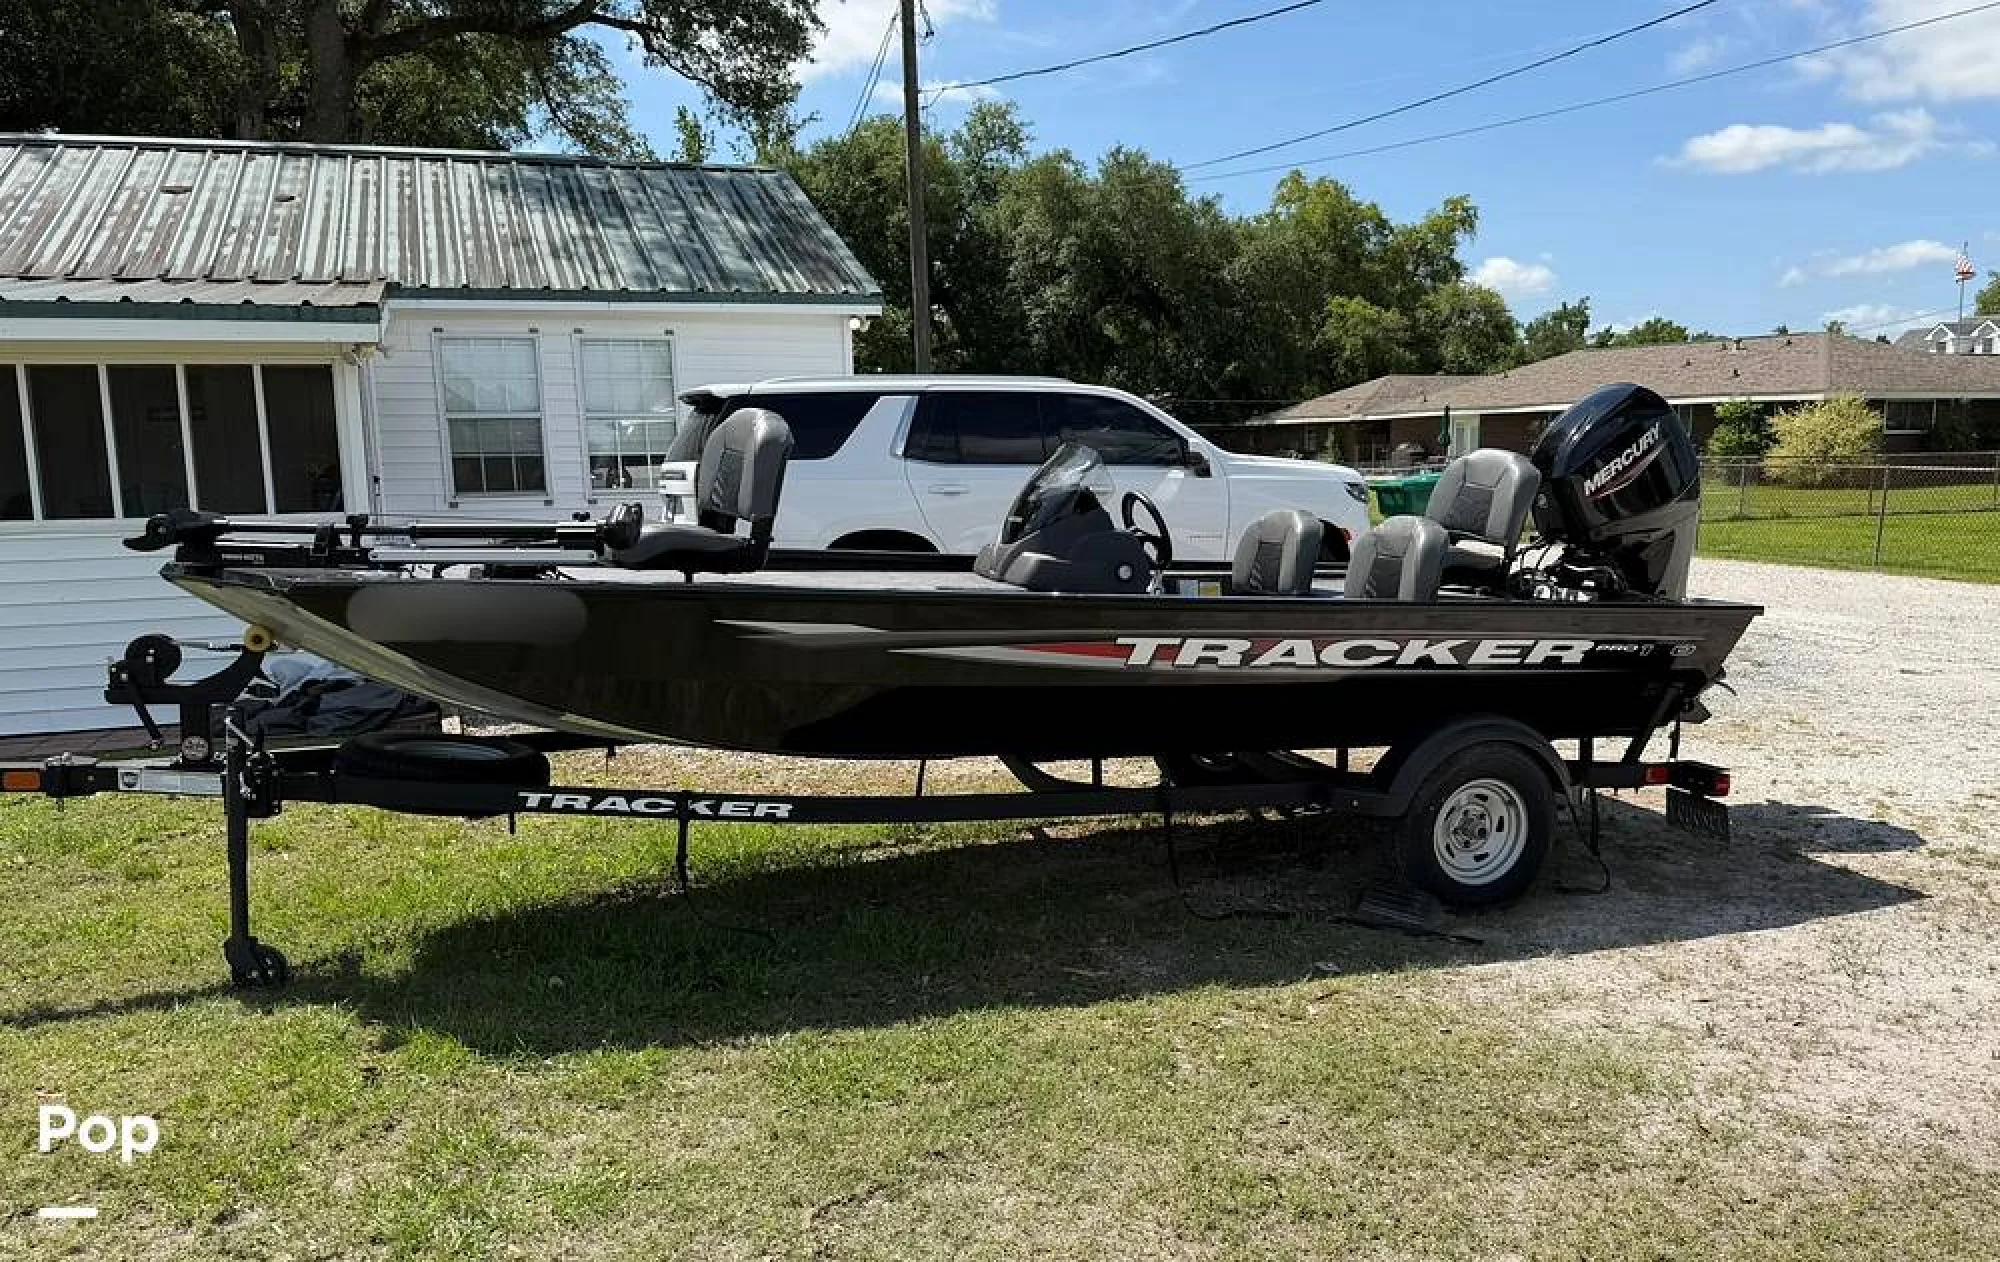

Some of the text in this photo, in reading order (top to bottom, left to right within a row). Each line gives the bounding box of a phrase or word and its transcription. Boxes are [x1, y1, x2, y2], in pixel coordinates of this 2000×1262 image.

[1583, 422, 1659, 496] MERCURY
[1115, 637, 1594, 666] TRACKER
[518, 791, 793, 818] TRACKER
